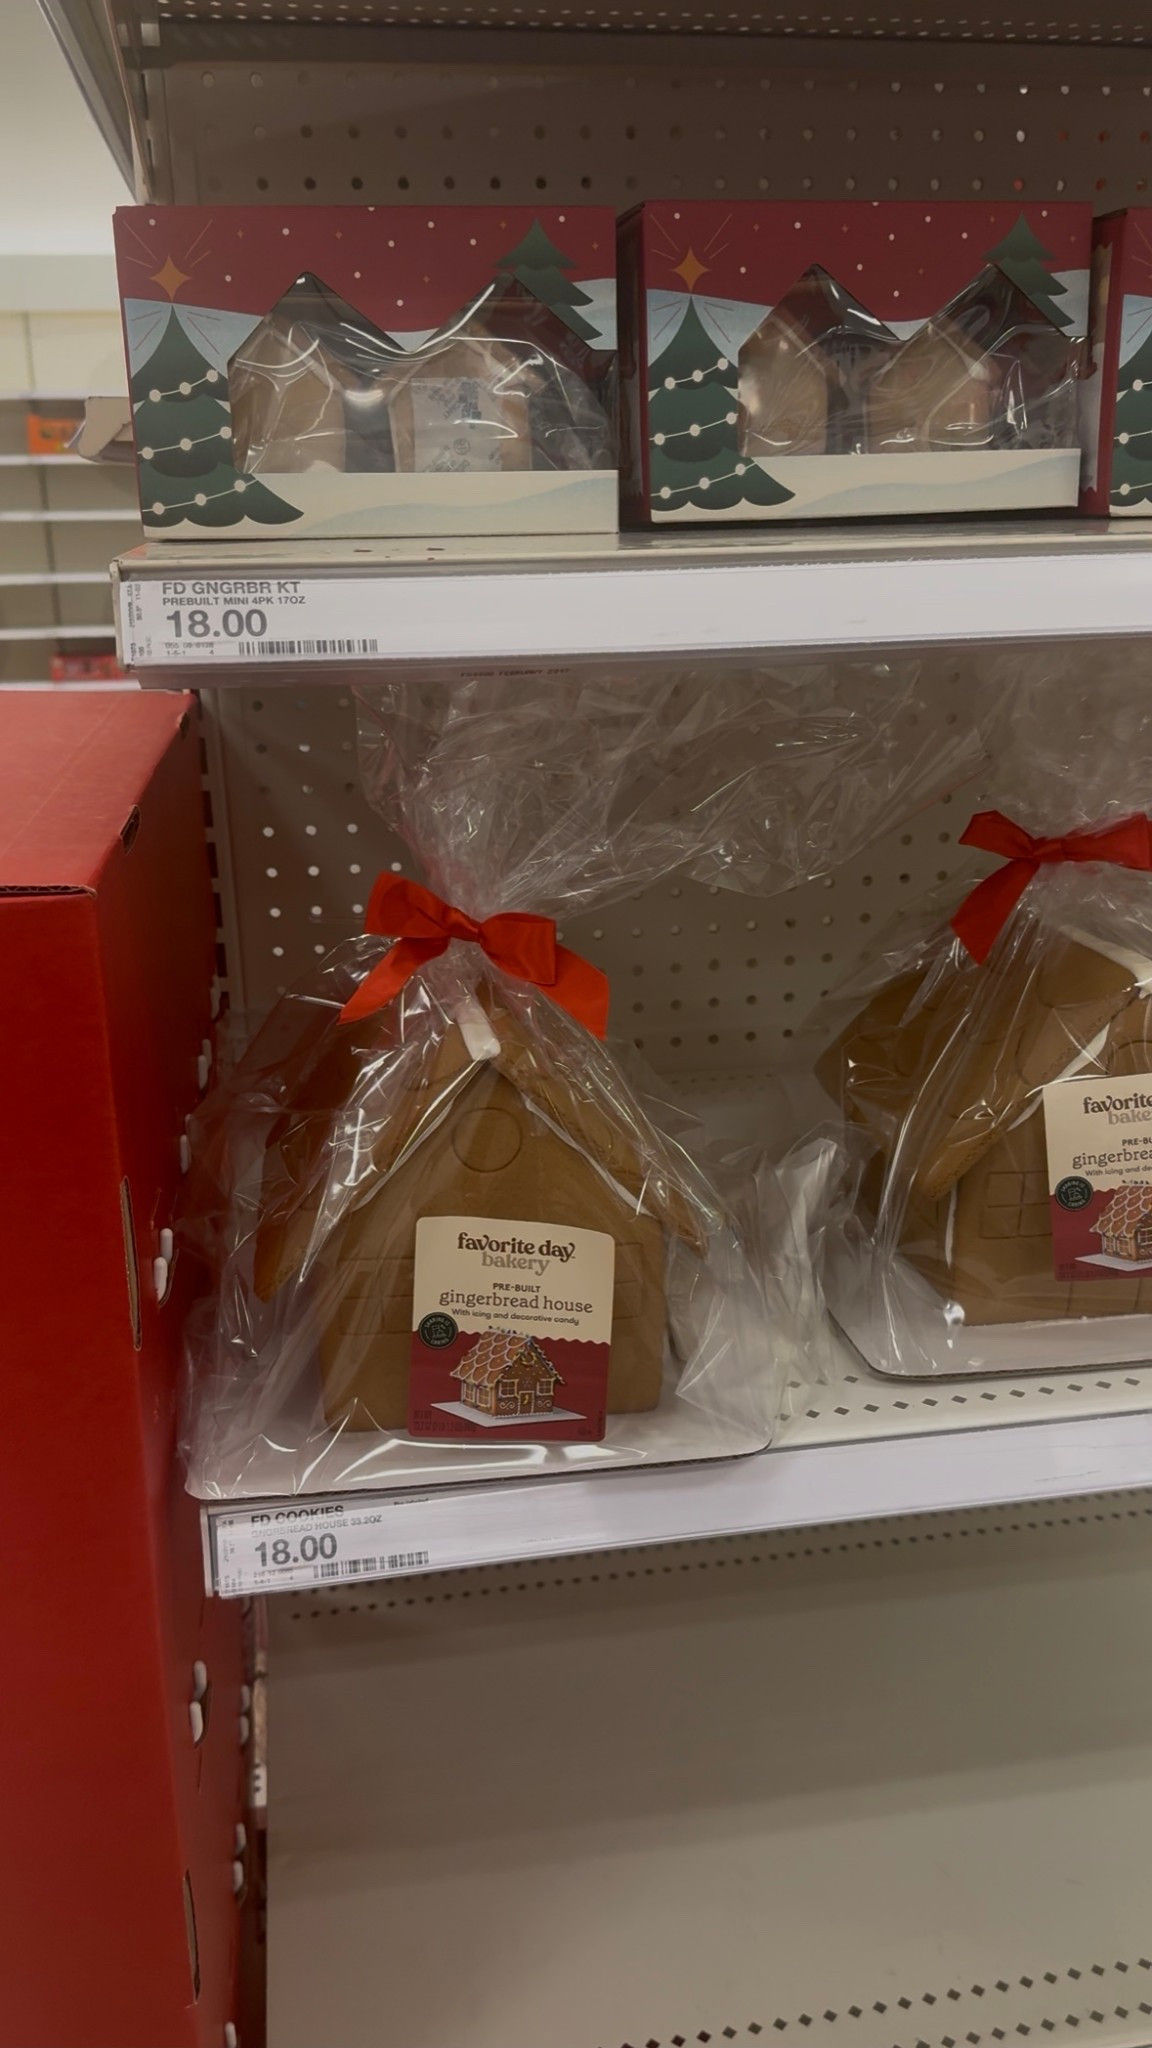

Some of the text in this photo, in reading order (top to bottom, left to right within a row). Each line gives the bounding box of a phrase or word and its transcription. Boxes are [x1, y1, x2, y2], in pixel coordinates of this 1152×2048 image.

[162, 581, 301, 595] FD GNGRBR KT
[162, 596, 306, 606] PREBUILT MINI 4PK 17OZ
[166, 608, 268, 638] 18.00
[1083, 1092, 1152, 1114] favorite
[1107, 1109, 1152, 1125] bake
[1085, 1169, 1104, 1177] With
[1104, 1168, 1124, 1176] icing
[457, 1232, 576, 1263] favorite day
[482, 1251, 550, 1276] bakery
[492, 1282, 541, 1293] PRE-BUILT
[439, 1290, 593, 1313] gingerbread house
[451, 1308, 580, 1326] With icing and decorative candy
[251, 1514, 271, 1527] FD
[275, 1505, 344, 1525] COOKIES
[315, 1519, 349, 1531] HOUSE
[350, 1515, 383, 1526] 33.2OZ
[254, 1532, 338, 1567] 18.00
